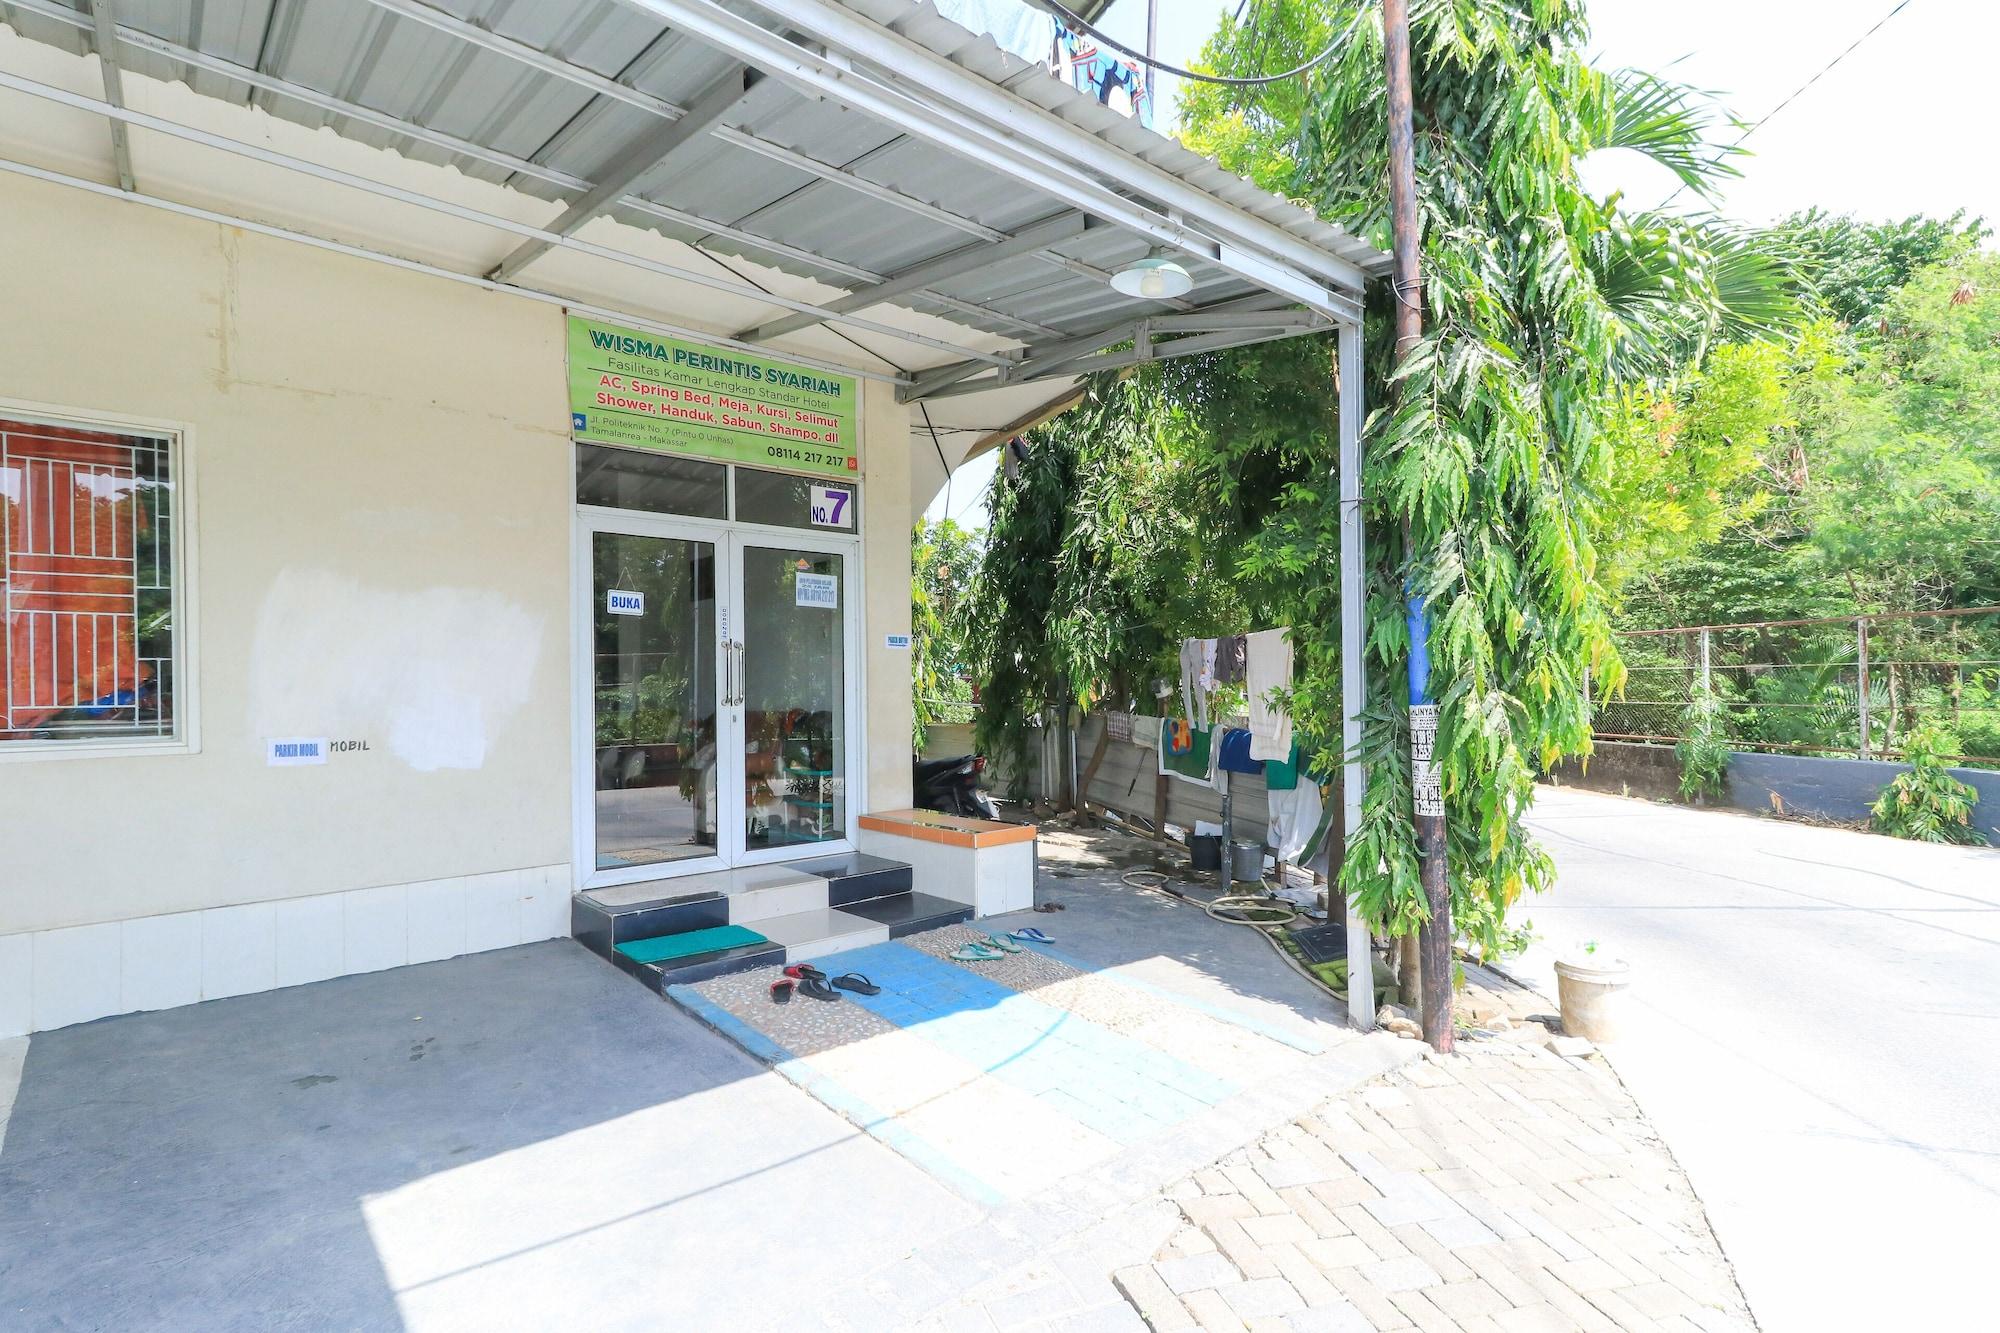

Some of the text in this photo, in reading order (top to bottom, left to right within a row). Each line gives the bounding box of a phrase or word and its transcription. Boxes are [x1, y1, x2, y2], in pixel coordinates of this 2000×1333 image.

[589, 329, 840, 398] WISMA PERINTIS SYARIAH
[608, 357, 830, 409] Fasilitas Kamar Lengkap Standar Hotel
[600, 375, 838, 428] AC, Spring Bed, Meja, Kursi, Selimut
[596, 392, 838, 443] Shower, Handuk, Sabun, Shampo, dll
[591, 426, 641, 441] Tamalanrea
[649, 435, 688, 447] Makassar
[603, 418, 646, 431] Politeknik
[648, 425, 662, 434] No.
[665, 427, 670, 435] 7
[671, 429, 697, 440] (Pintu
[706, 434, 734, 446] Unhas)
[767, 446, 844, 468] 08114 217 217
[812, 490, 849, 524] NO. 7
[611, 596, 640, 609] BUKA
[275, 743, 319, 757] PARKIR MOBIL
[330, 740, 370, 752] MOBIL
